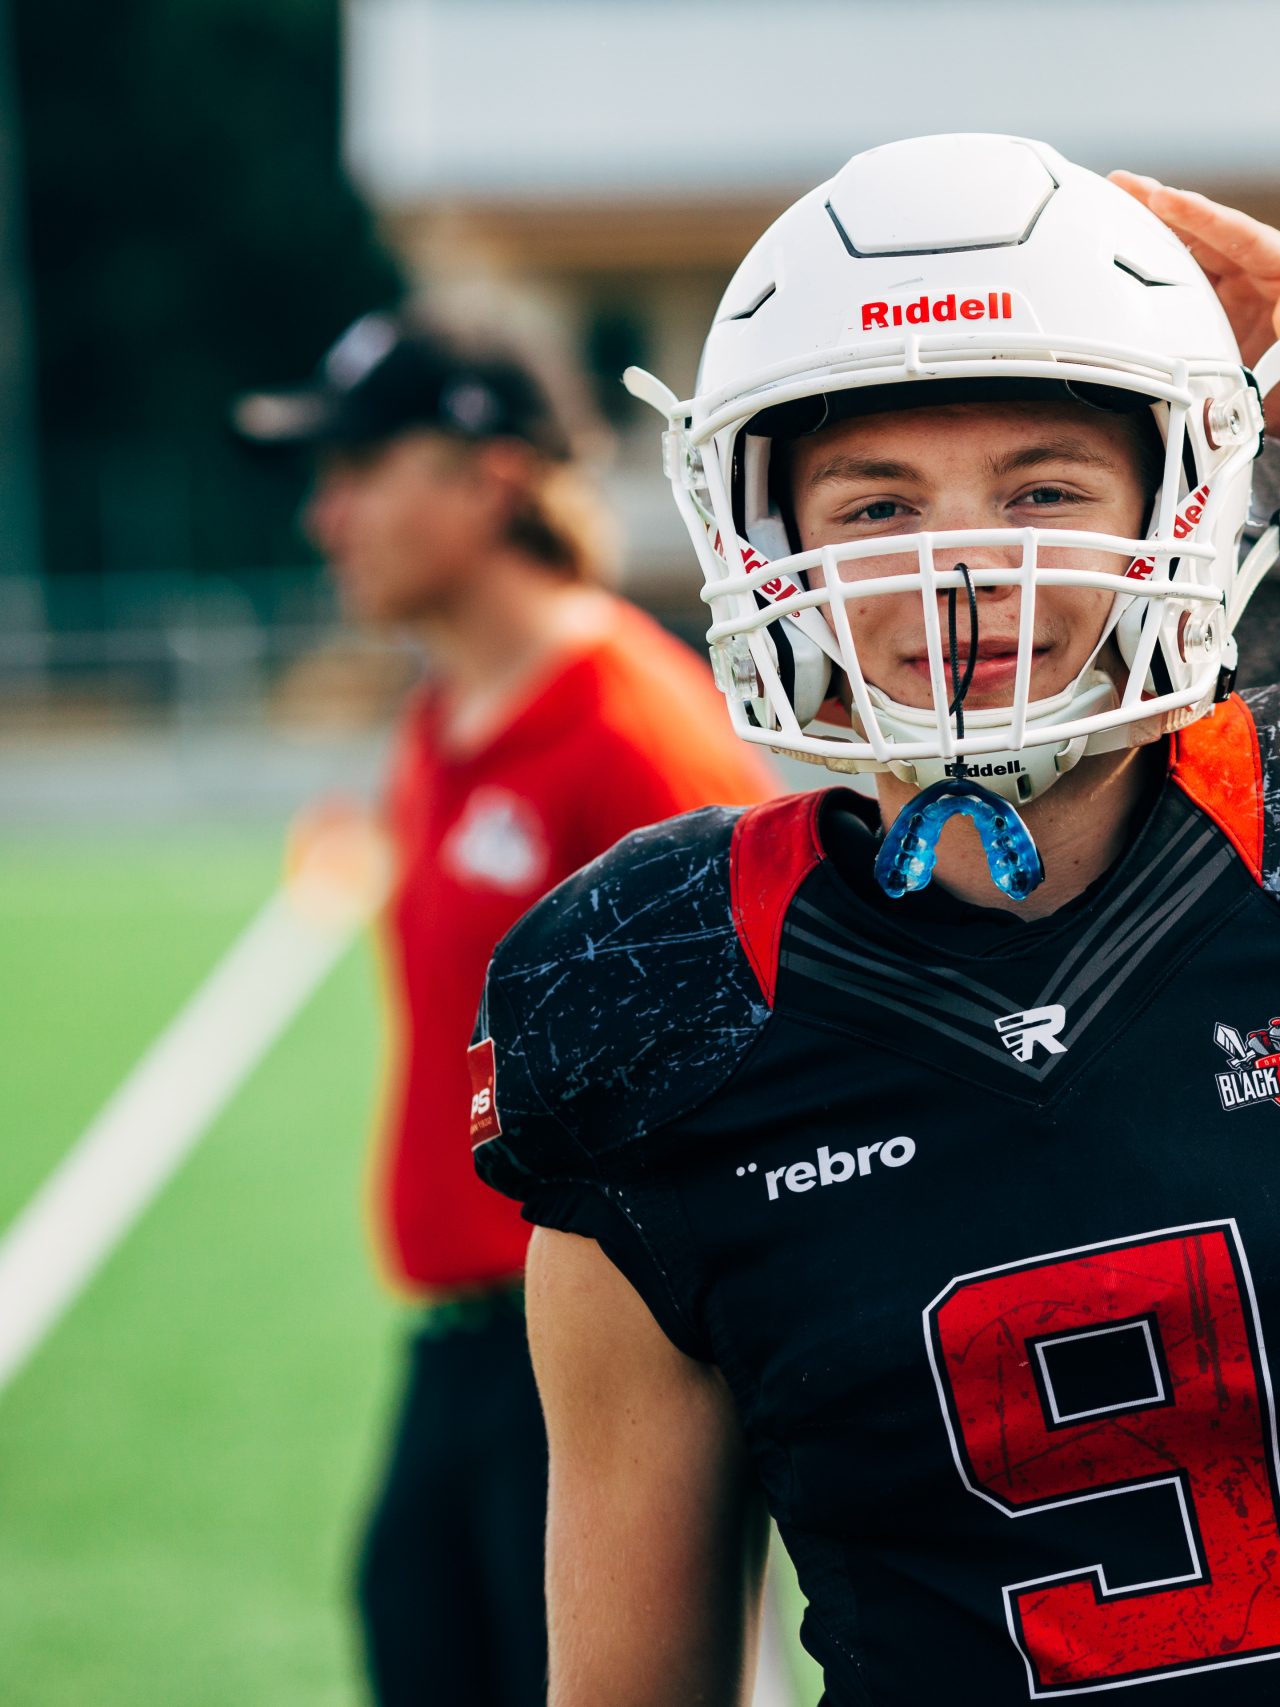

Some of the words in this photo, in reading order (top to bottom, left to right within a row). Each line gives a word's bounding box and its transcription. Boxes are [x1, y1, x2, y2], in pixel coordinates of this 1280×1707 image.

[861, 292, 1012, 331] Riddell
[1125, 484, 1211, 581] Rdell
[944, 760, 1021, 778] Rddell
[1219, 1067, 1280, 1107] BLACK
